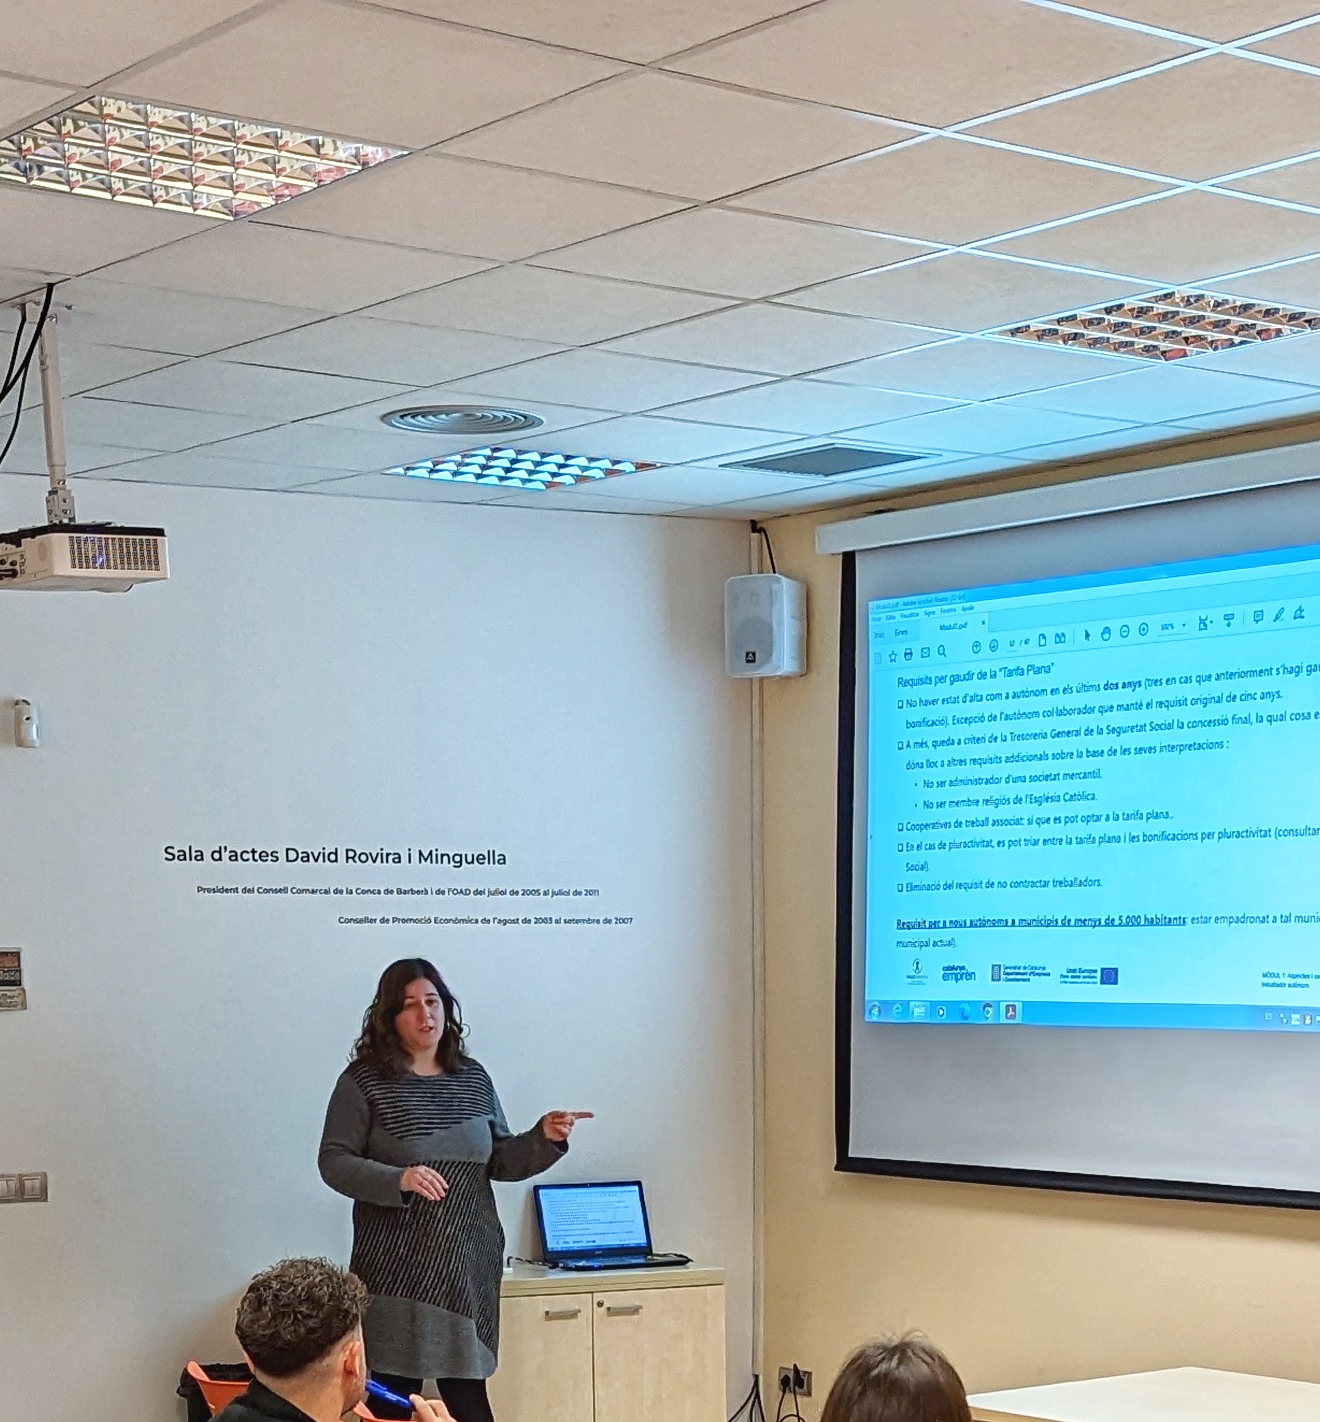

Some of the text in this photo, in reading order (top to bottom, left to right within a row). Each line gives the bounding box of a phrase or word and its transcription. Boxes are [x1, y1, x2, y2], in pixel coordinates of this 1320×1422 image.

[163, 844, 506, 868] Sala d'actes David Rovira i Minguella
[196, 885, 239, 894] President
[241, 886, 255, 894] del
[256, 886, 288, 894] Consell
[289, 886, 331, 895] Comarcal
[332, 887, 344, 895] de
[345, 886, 353, 895] la
[354, 887, 381, 895] Conca
[383, 887, 394, 895] de
[395, 887, 428, 895] Barberà
[434, 887, 445, 895] de
[472, 888, 485, 896] del
[508, 888, 519, 896] de
[571, 888, 583, 896] de
[337, 916, 377, 924] Conseller
[378, 916, 390, 924] de
[480, 916, 490, 924] de
[521, 916, 531, 924] de
[554, 916, 561, 924] al
[614, 916, 633, 924] 2007
